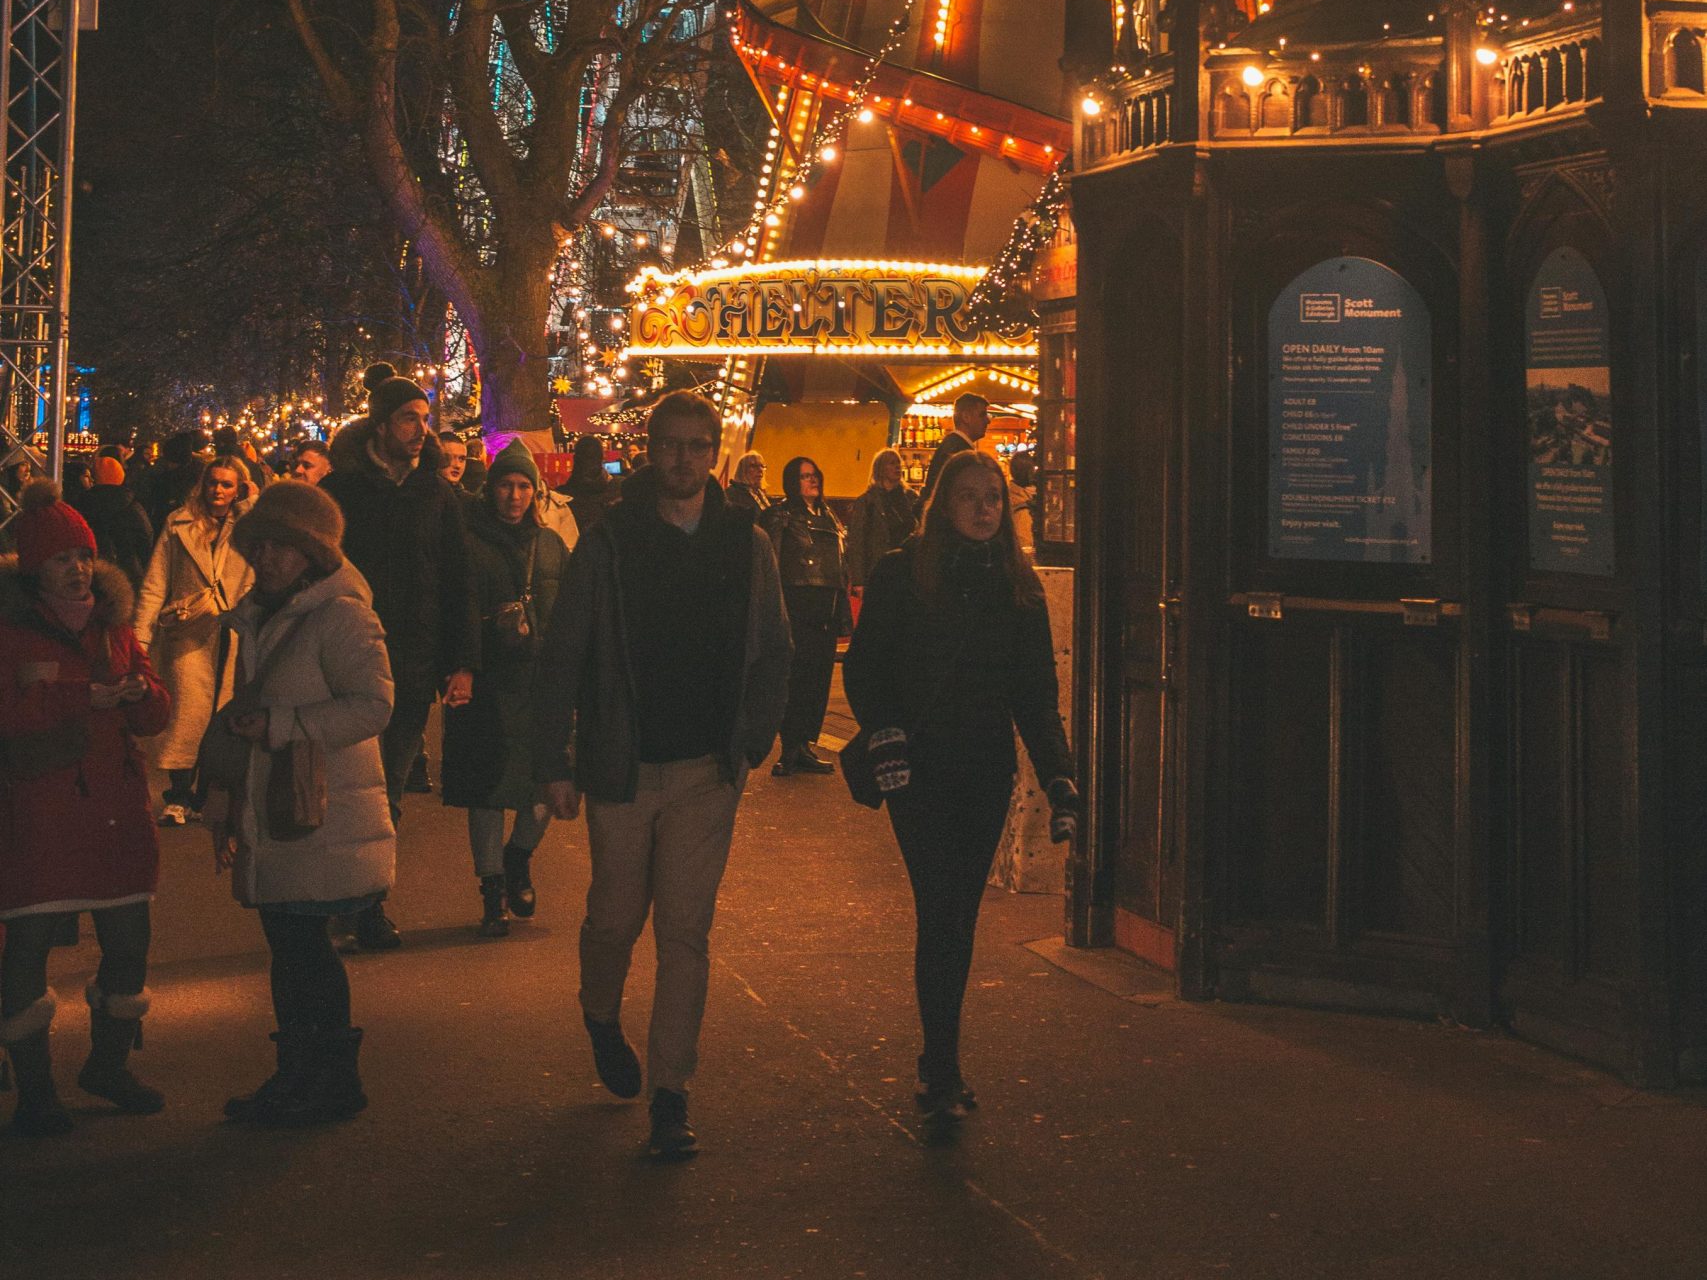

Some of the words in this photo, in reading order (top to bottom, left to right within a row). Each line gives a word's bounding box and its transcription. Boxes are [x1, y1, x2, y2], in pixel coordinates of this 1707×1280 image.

[1344, 298, 1373, 308] Scott
[706, 277, 981, 345] HELTER
[1344, 308, 1402, 318] Monument
[1282, 344, 1310, 354] OPEN
[1312, 344, 1340, 354] DAILY
[1342, 345, 1361, 354] from
[1362, 346, 1384, 354] 10am
[1283, 398, 1306, 406] ADULT
[1282, 410, 1303, 418] CHILD
[1282, 423, 1303, 431] CHILD
[1304, 423, 1330, 431] UNDER
[68, 432, 99, 445] PITCH
[1282, 434, 1333, 442] CONCESSIONS
[1281, 519, 1302, 529] Enjoy
[1303, 521, 1318, 529] your
